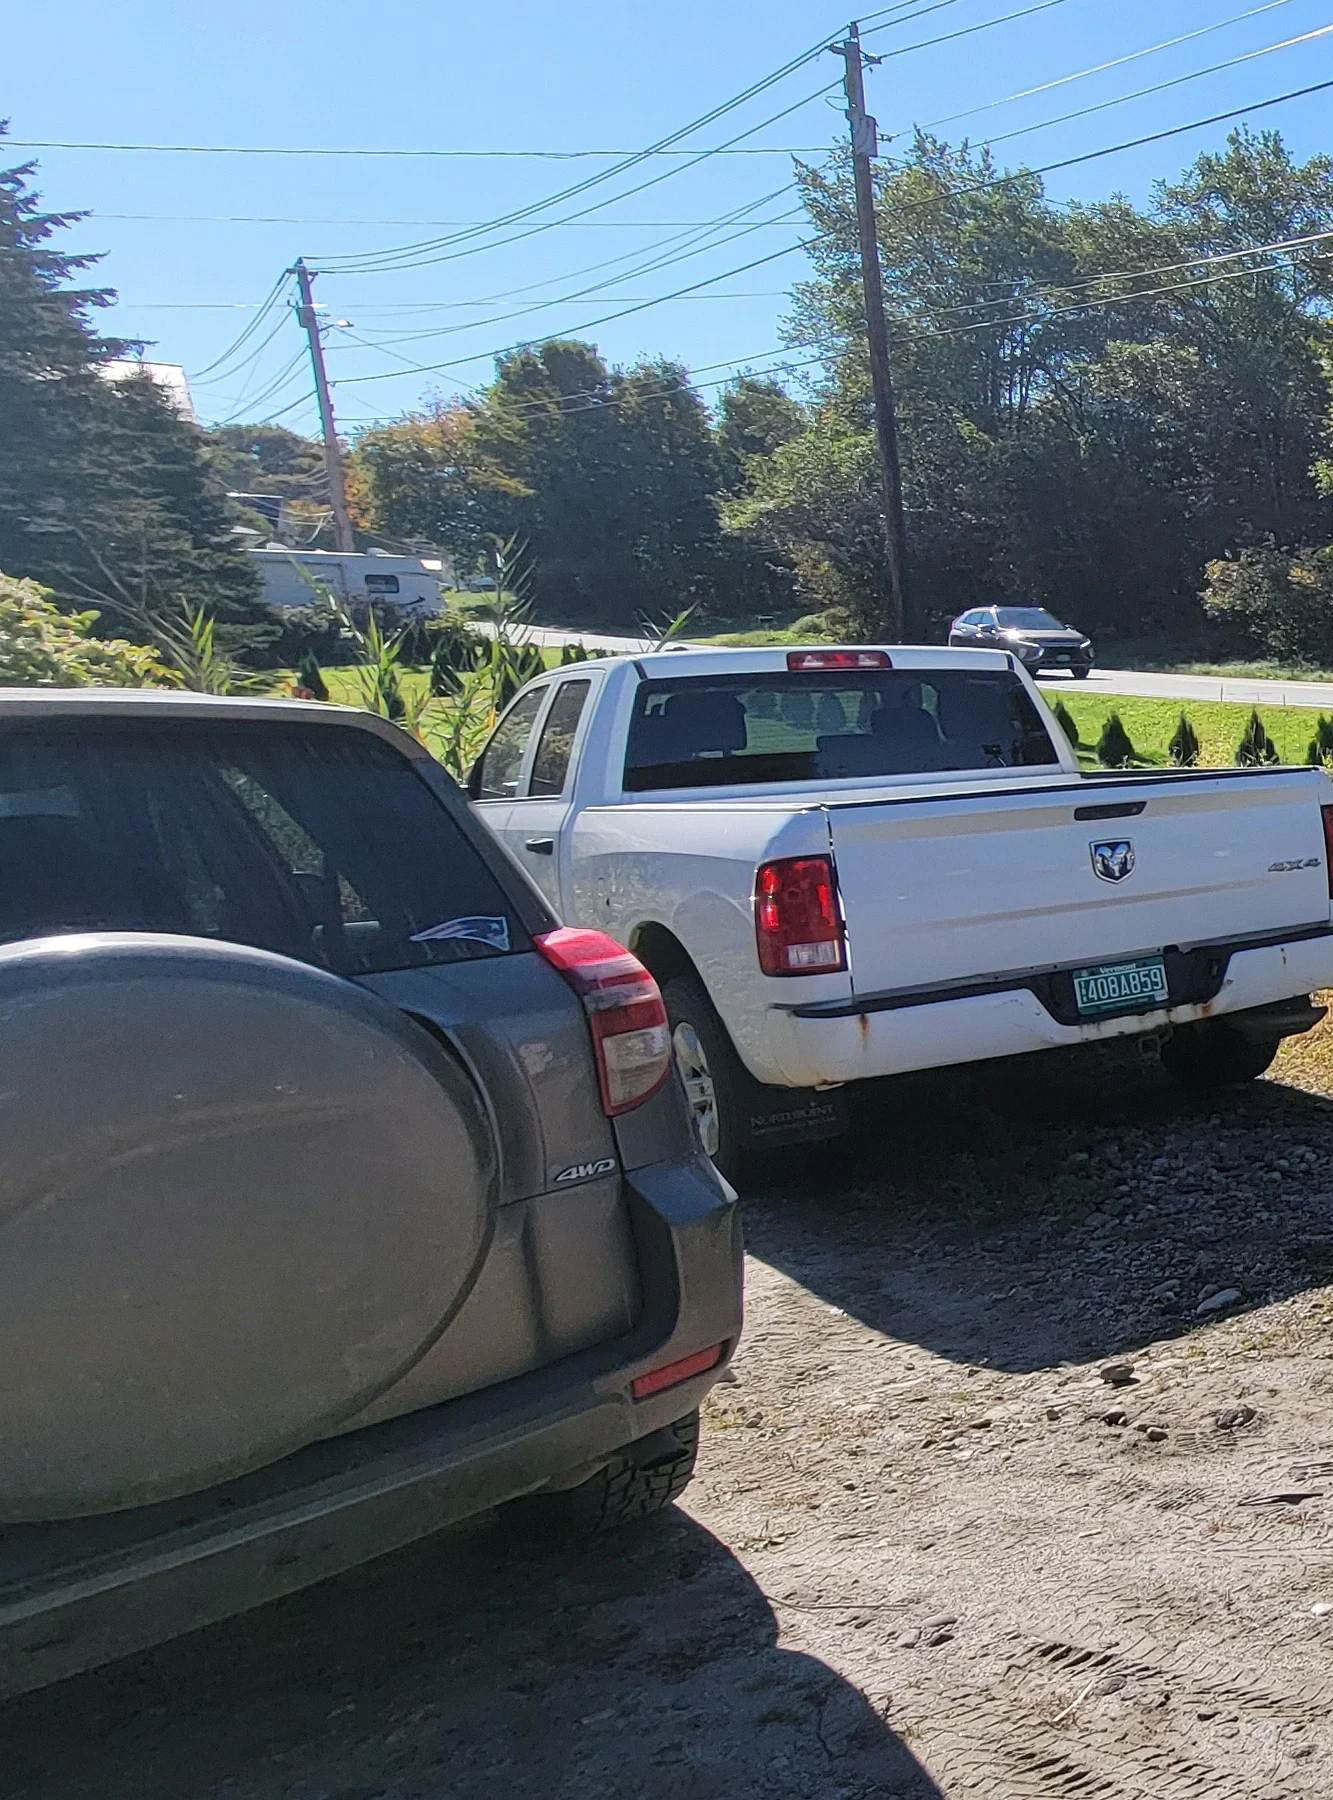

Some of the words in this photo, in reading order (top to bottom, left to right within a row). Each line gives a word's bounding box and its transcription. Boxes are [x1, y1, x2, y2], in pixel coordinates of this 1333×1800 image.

[1099, 962, 1137, 974] Vermont
[1088, 969, 1162, 1001] 408A859
[556, 1158, 616, 1182] 4WD
